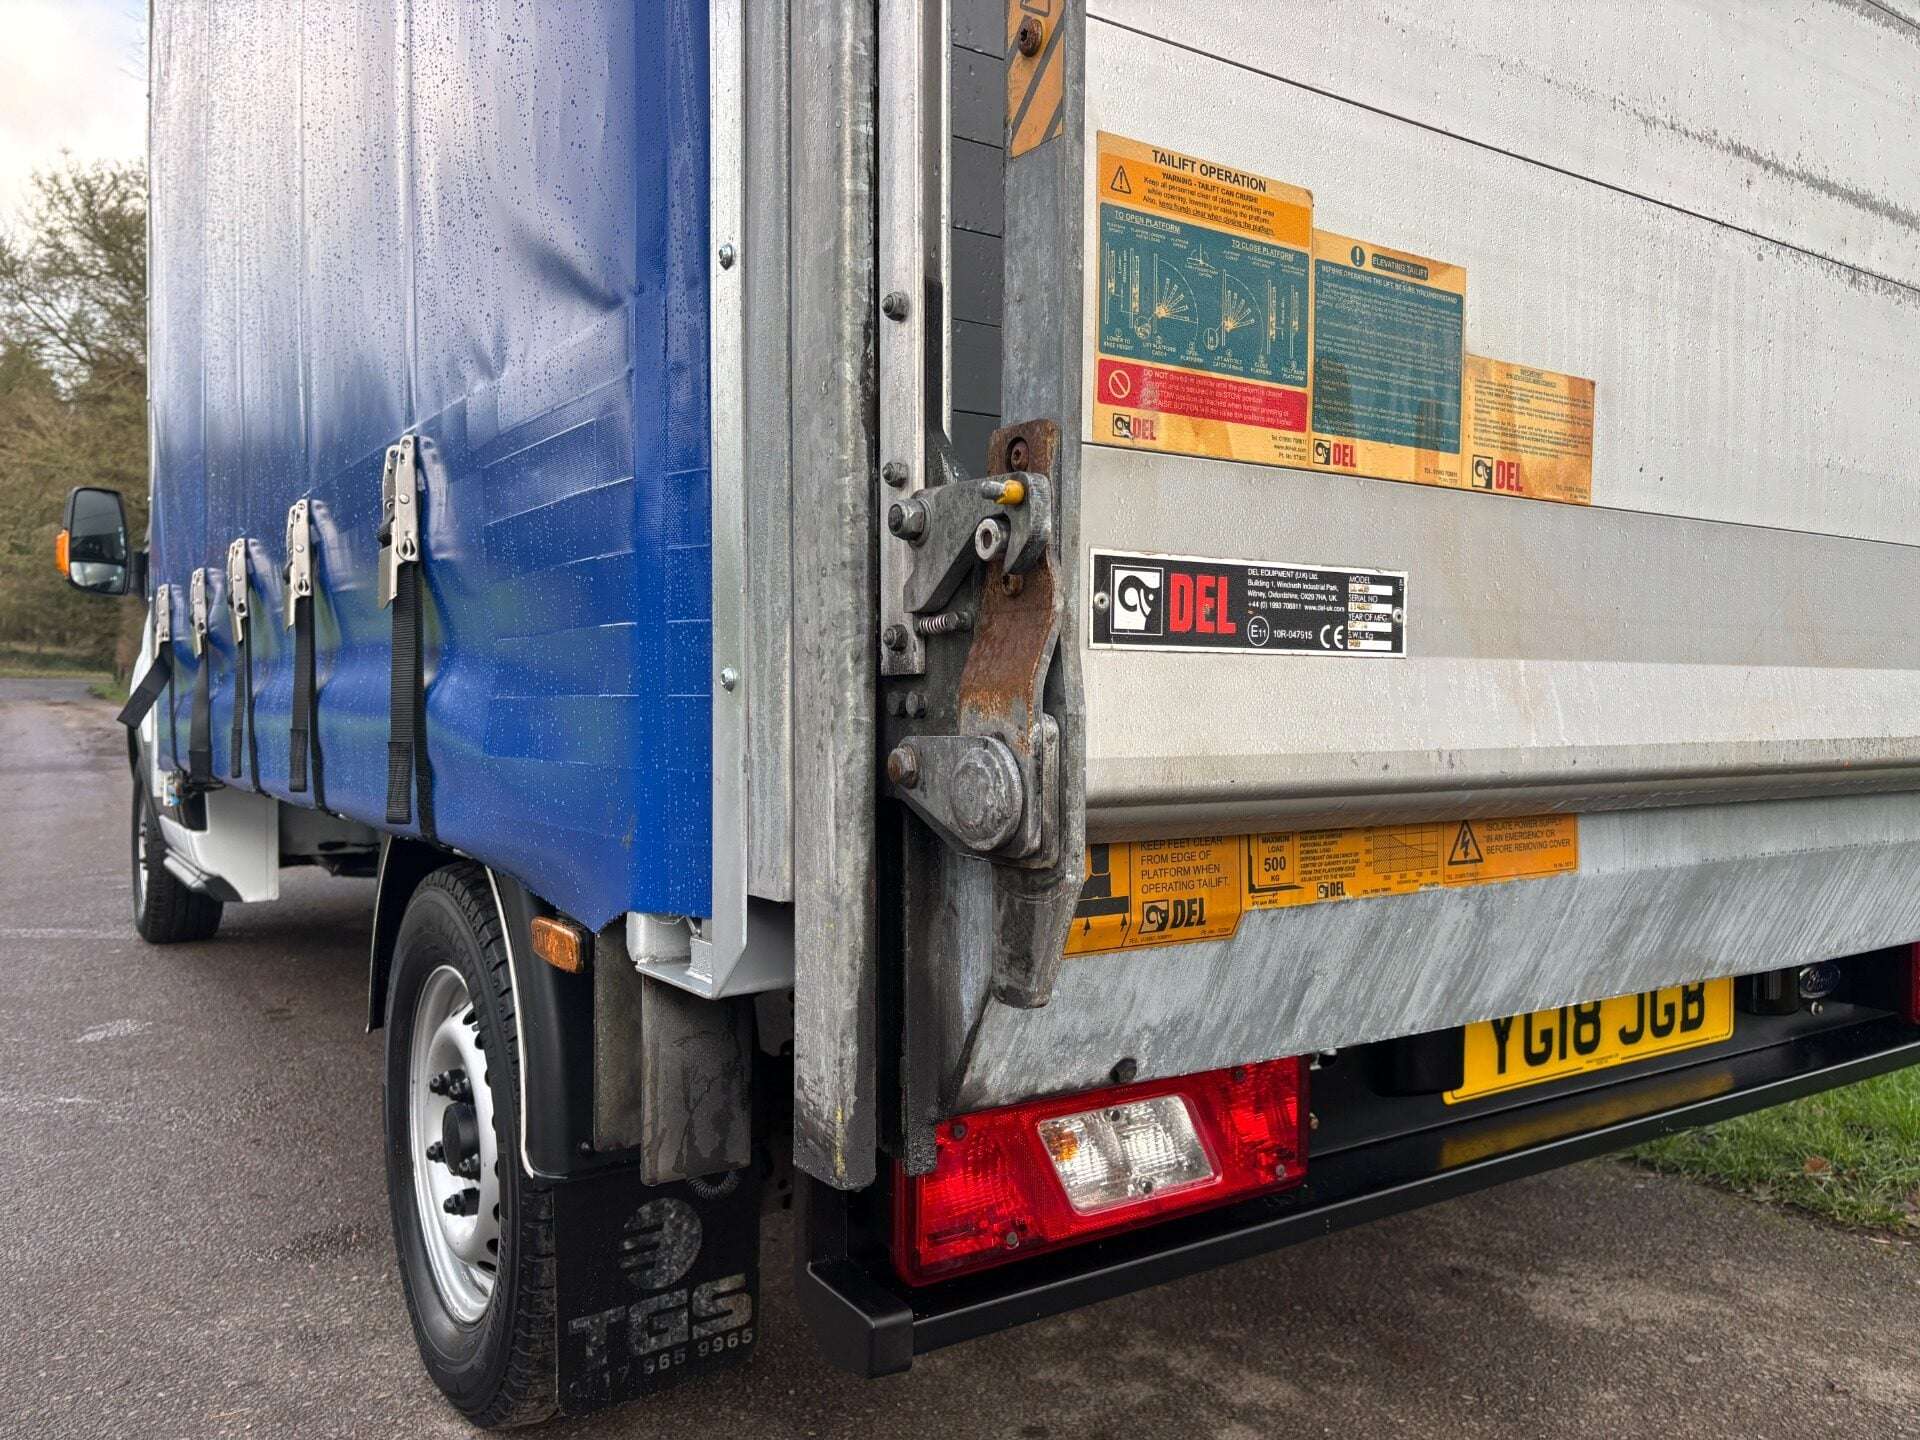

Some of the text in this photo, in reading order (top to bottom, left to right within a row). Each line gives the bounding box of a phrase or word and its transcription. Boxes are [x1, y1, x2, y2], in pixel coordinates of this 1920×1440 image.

[1152, 149, 1266, 193] TAILIFT OPERATION
[1162, 172, 1193, 186] WARNING
[1198, 181, 1220, 193] TAILIFT
[1221, 187, 1234, 197] CAN
[1144, 177, 1160, 188] Keep
[1218, 195, 1241, 209] platform
[1241, 202, 1262, 215] working
[1262, 207, 1275, 217] area
[1114, 210, 1182, 234] TO OPEN PLATFORM
[1231, 239, 1241, 248] TO
[1261, 245, 1296, 262] PLATFORM
[1372, 257, 1428, 277] ELEVATING TAILIFT
[1143, 368, 1154, 378] DO
[1154, 370, 1169, 380] NOT
[1132, 416, 1157, 441] DEL
[1332, 442, 1357, 468] DEL
[1495, 460, 1523, 492] DEL
[1248, 568, 1260, 576] DEL
[1260, 569, 1294, 578] EQUIPMENT
[1349, 576, 1371, 584] MODEL
[1248, 579, 1270, 589] Building
[1277, 581, 1302, 590] Windrush
[1303, 583, 1326, 591] Industrial
[1169, 572, 1237, 635] DEL
[1348, 594, 1367, 603] SERIAL
[1304, 604, 1345, 612] www.del-uk.com
[1348, 613, 1363, 621] YEAR
[1320, 624, 1345, 649] CE
[1141, 836, 1224, 851] KEEP FEET CLEAR
[1504, 831, 1544, 843] EMERGENCY
[1545, 830, 1556, 838] OR
[1267, 844, 1286, 853] LOAD
[1486, 838, 1571, 855] BEFORE REMOVING COVER
[1141, 850, 1213, 866] FROM EDGE OF
[1264, 856, 1287, 873] 500
[1141, 863, 1221, 881] PLATFORM WHEN
[1270, 874, 1281, 882] KG
[1141, 880, 1195, 895] OPERATING
[1330, 881, 1346, 898] DEL
[1171, 897, 1207, 929] DEL
[568, 1273, 753, 1360] TGS
[643, 1328, 753, 1375] 965 9965
